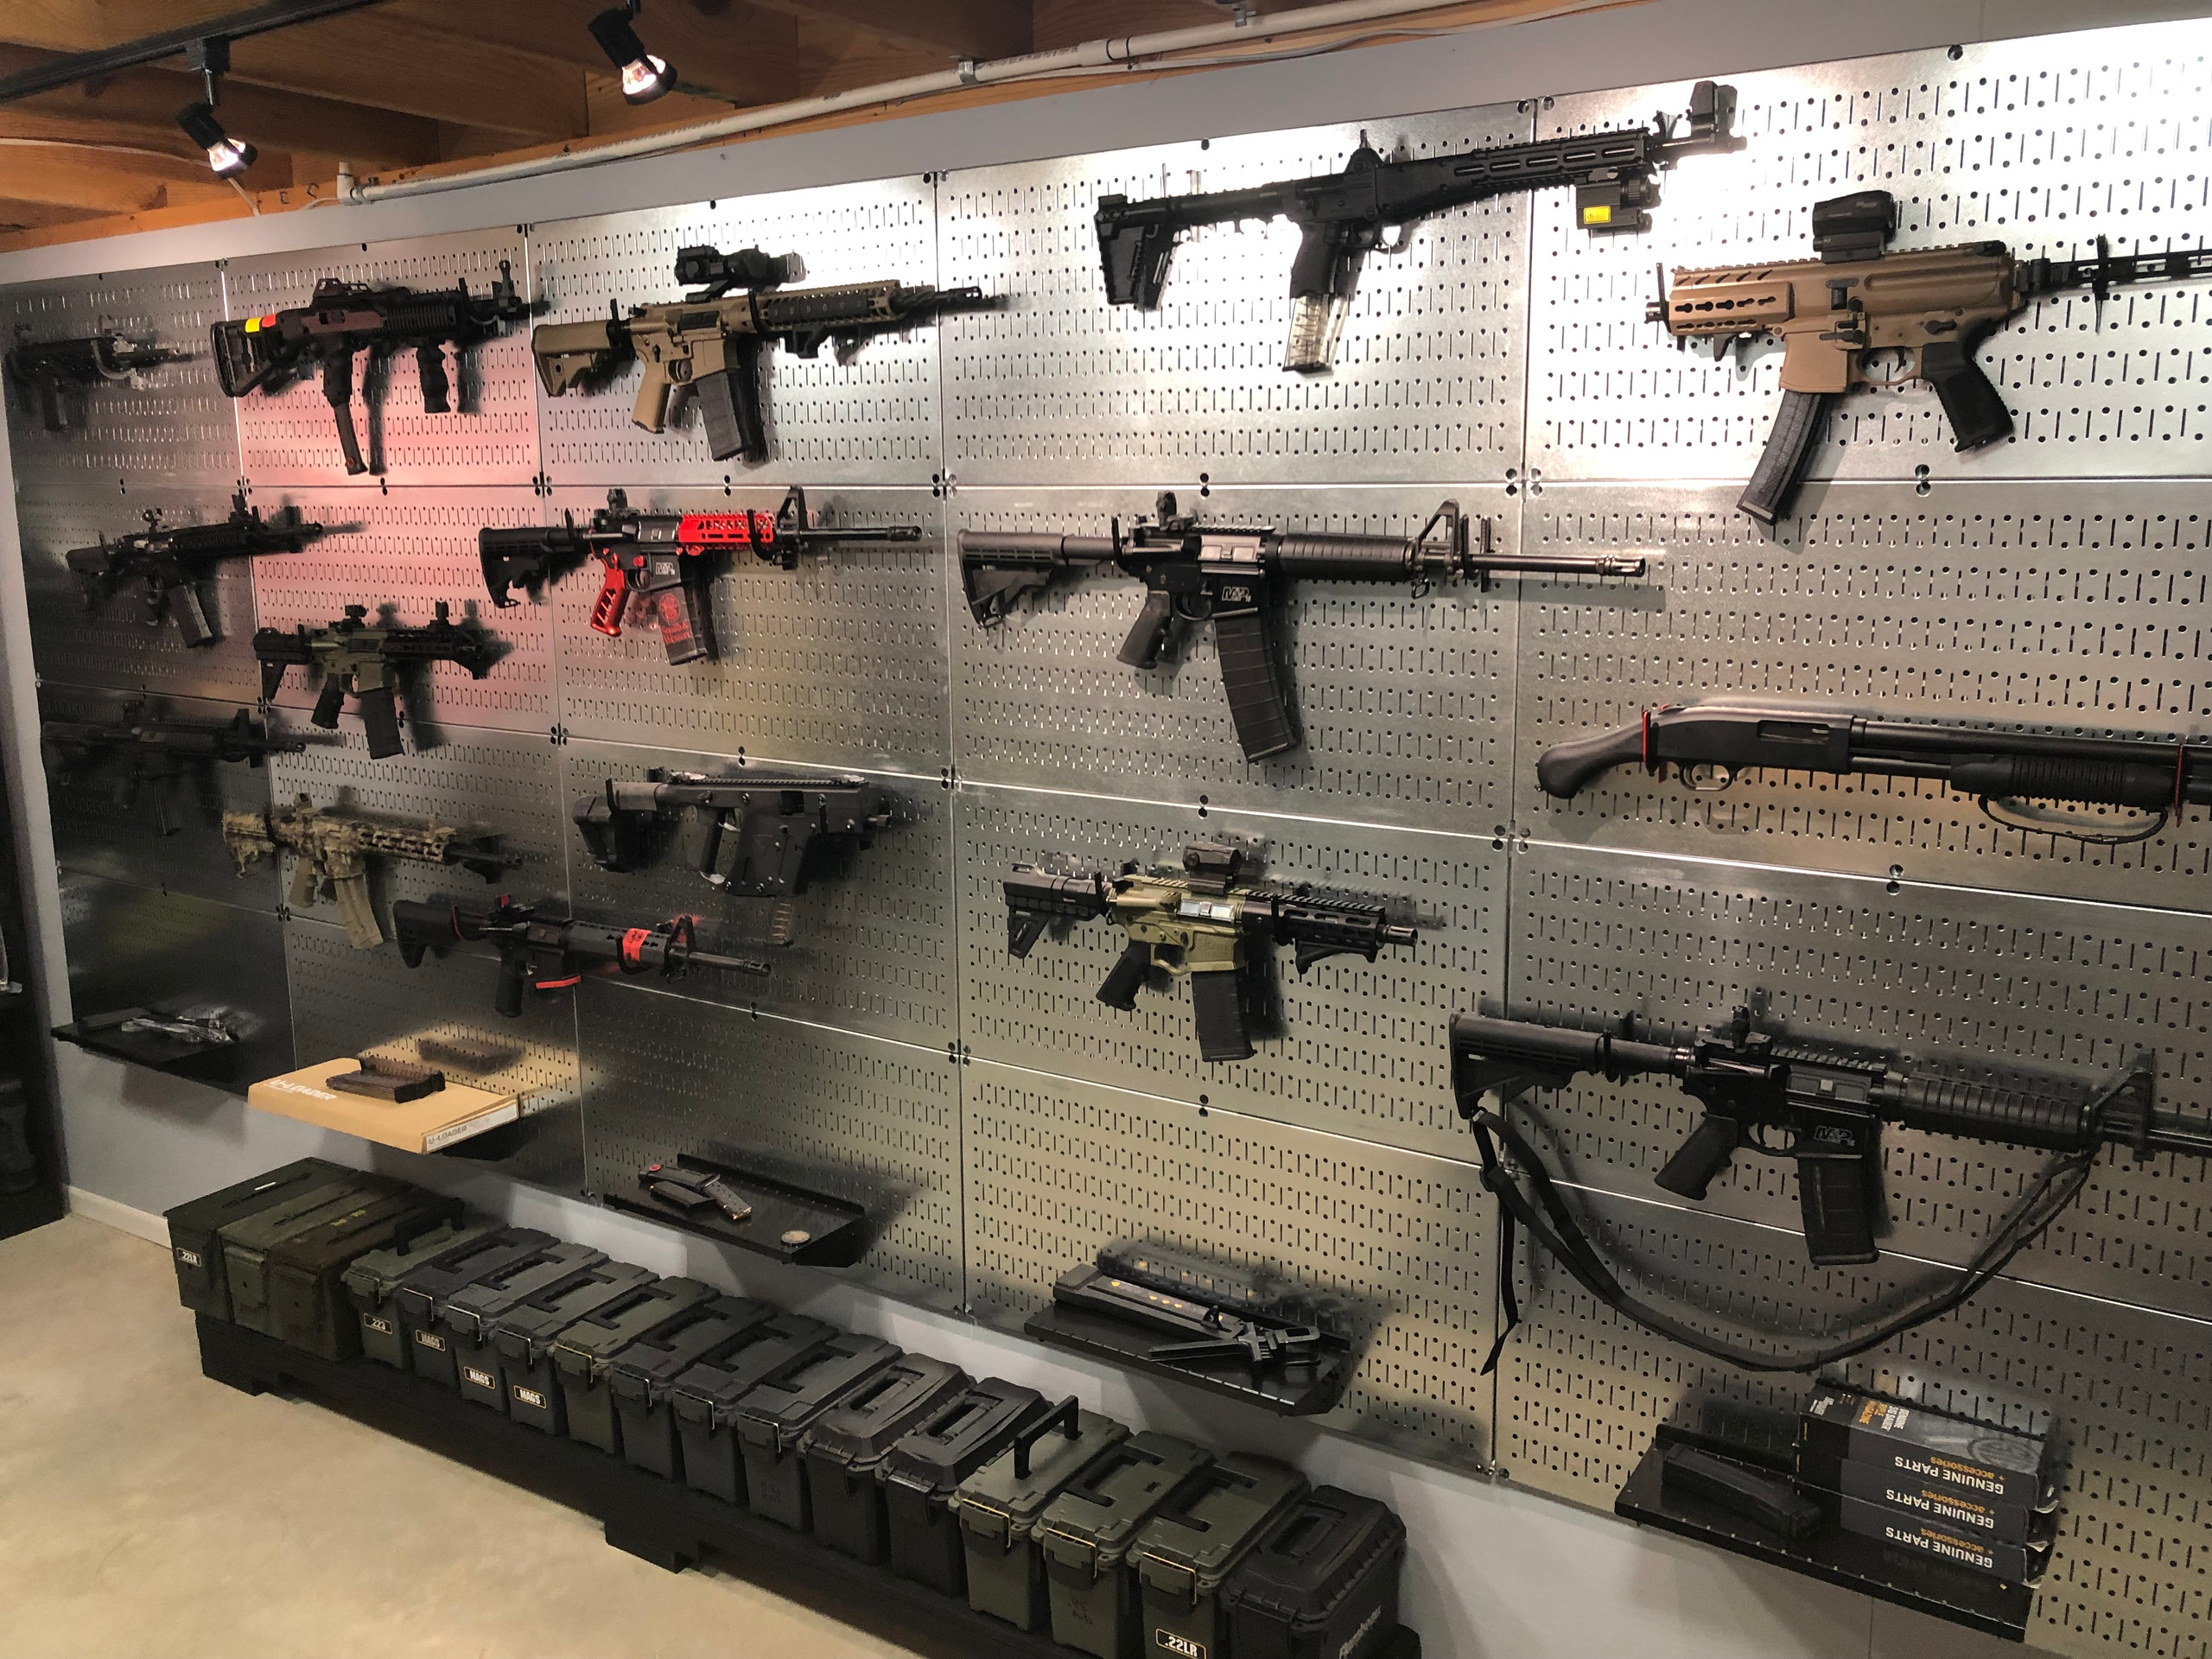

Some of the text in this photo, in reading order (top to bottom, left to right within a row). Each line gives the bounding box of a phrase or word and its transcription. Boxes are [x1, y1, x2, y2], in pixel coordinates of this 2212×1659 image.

[421, 1332, 441, 1348] MAGS
[469, 1370, 490, 1385] MAGS
[519, 1389, 541, 1405] MAGS
[1895, 1456, 2005, 1495] GENUINE PARTS
[1929, 1456, 1995, 1479] accessories
[1885, 1489, 1994, 1529] GENUINE PARTS
[1921, 1490, 1986, 1513] accessories
[1885, 1526, 1993, 1568] GENUINE PARTS
[1920, 1528, 1985, 1554] accessories
[1164, 1635, 1198, 1657] .22LR
